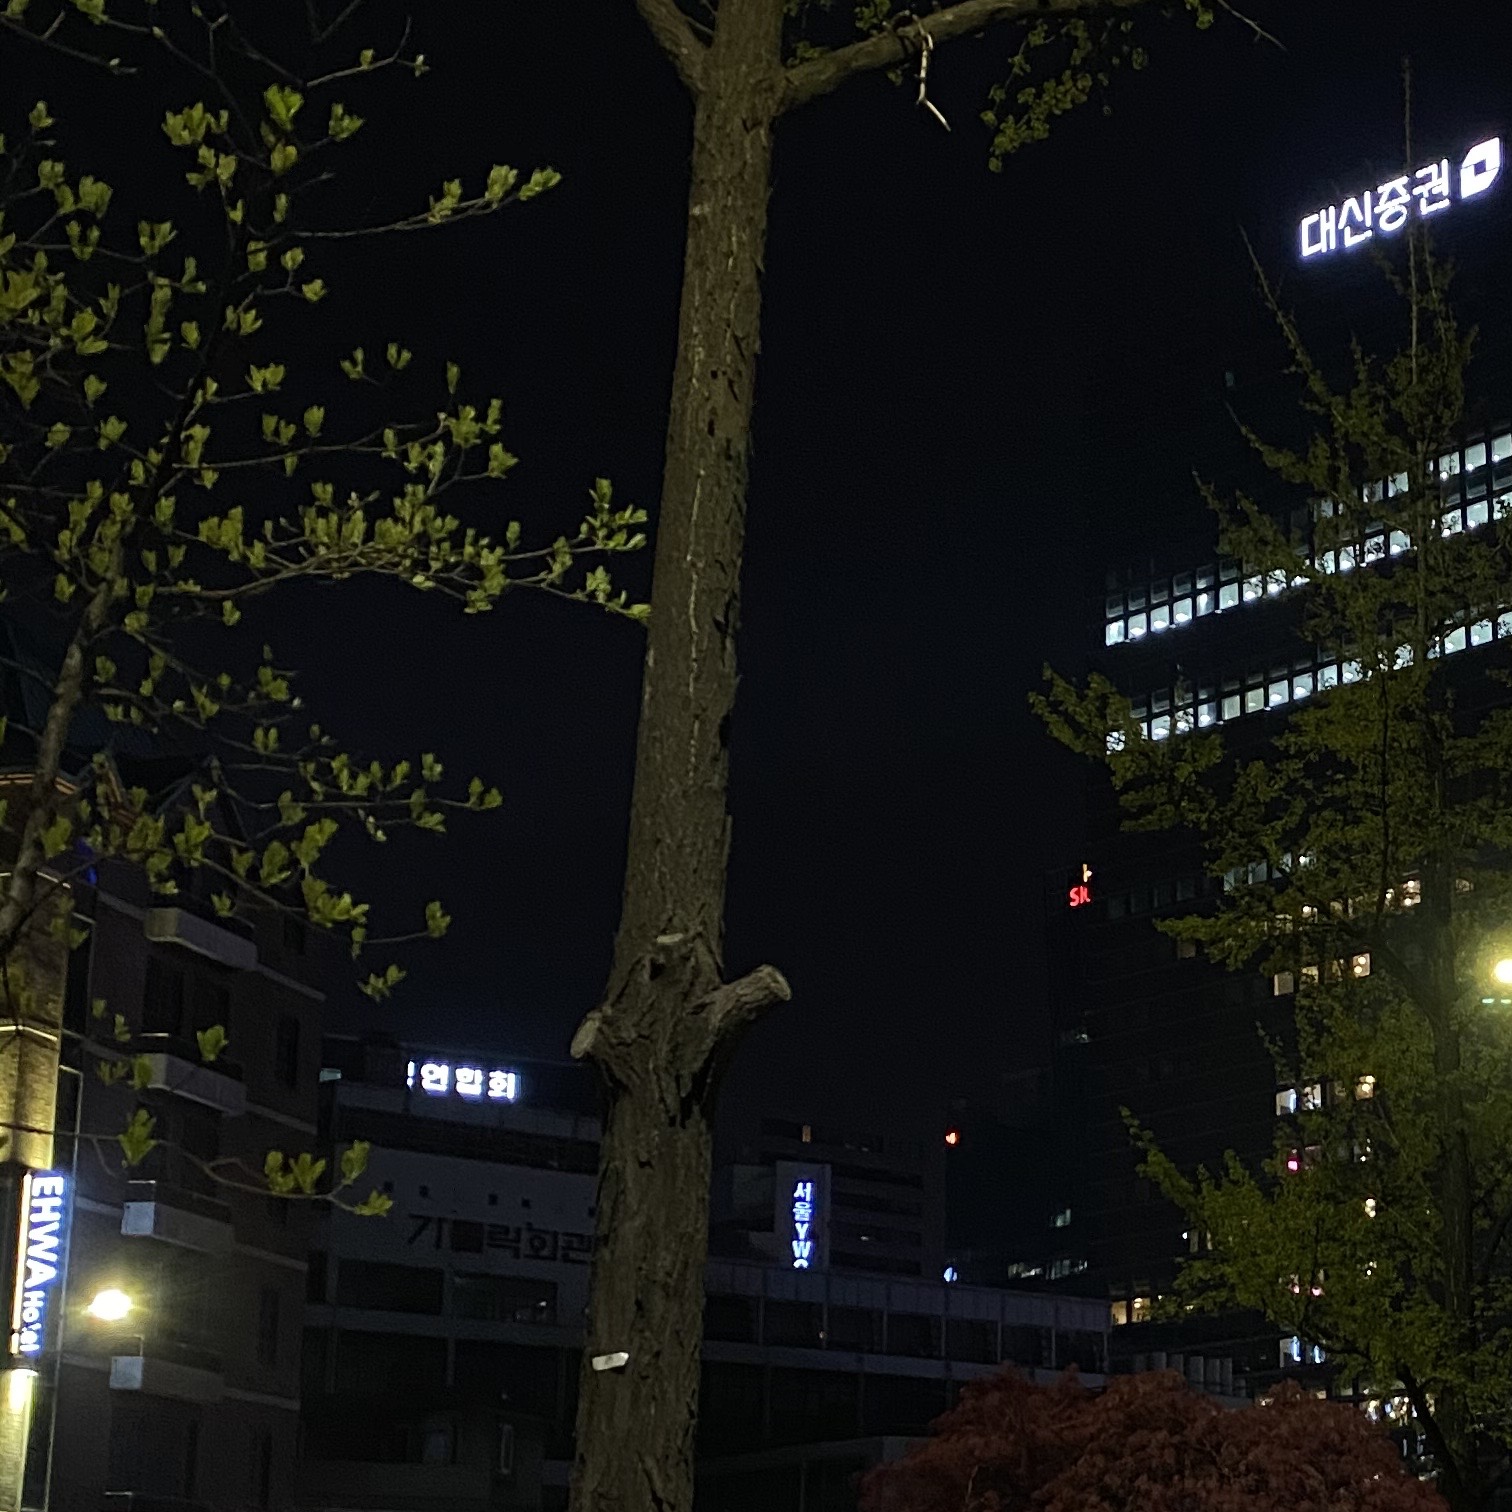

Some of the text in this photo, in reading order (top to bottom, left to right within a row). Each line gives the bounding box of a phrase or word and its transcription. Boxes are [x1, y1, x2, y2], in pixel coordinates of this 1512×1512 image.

[1300, 158, 1452, 258] 대신증권
[19, 1176, 65, 1352] EHWA Hotel
